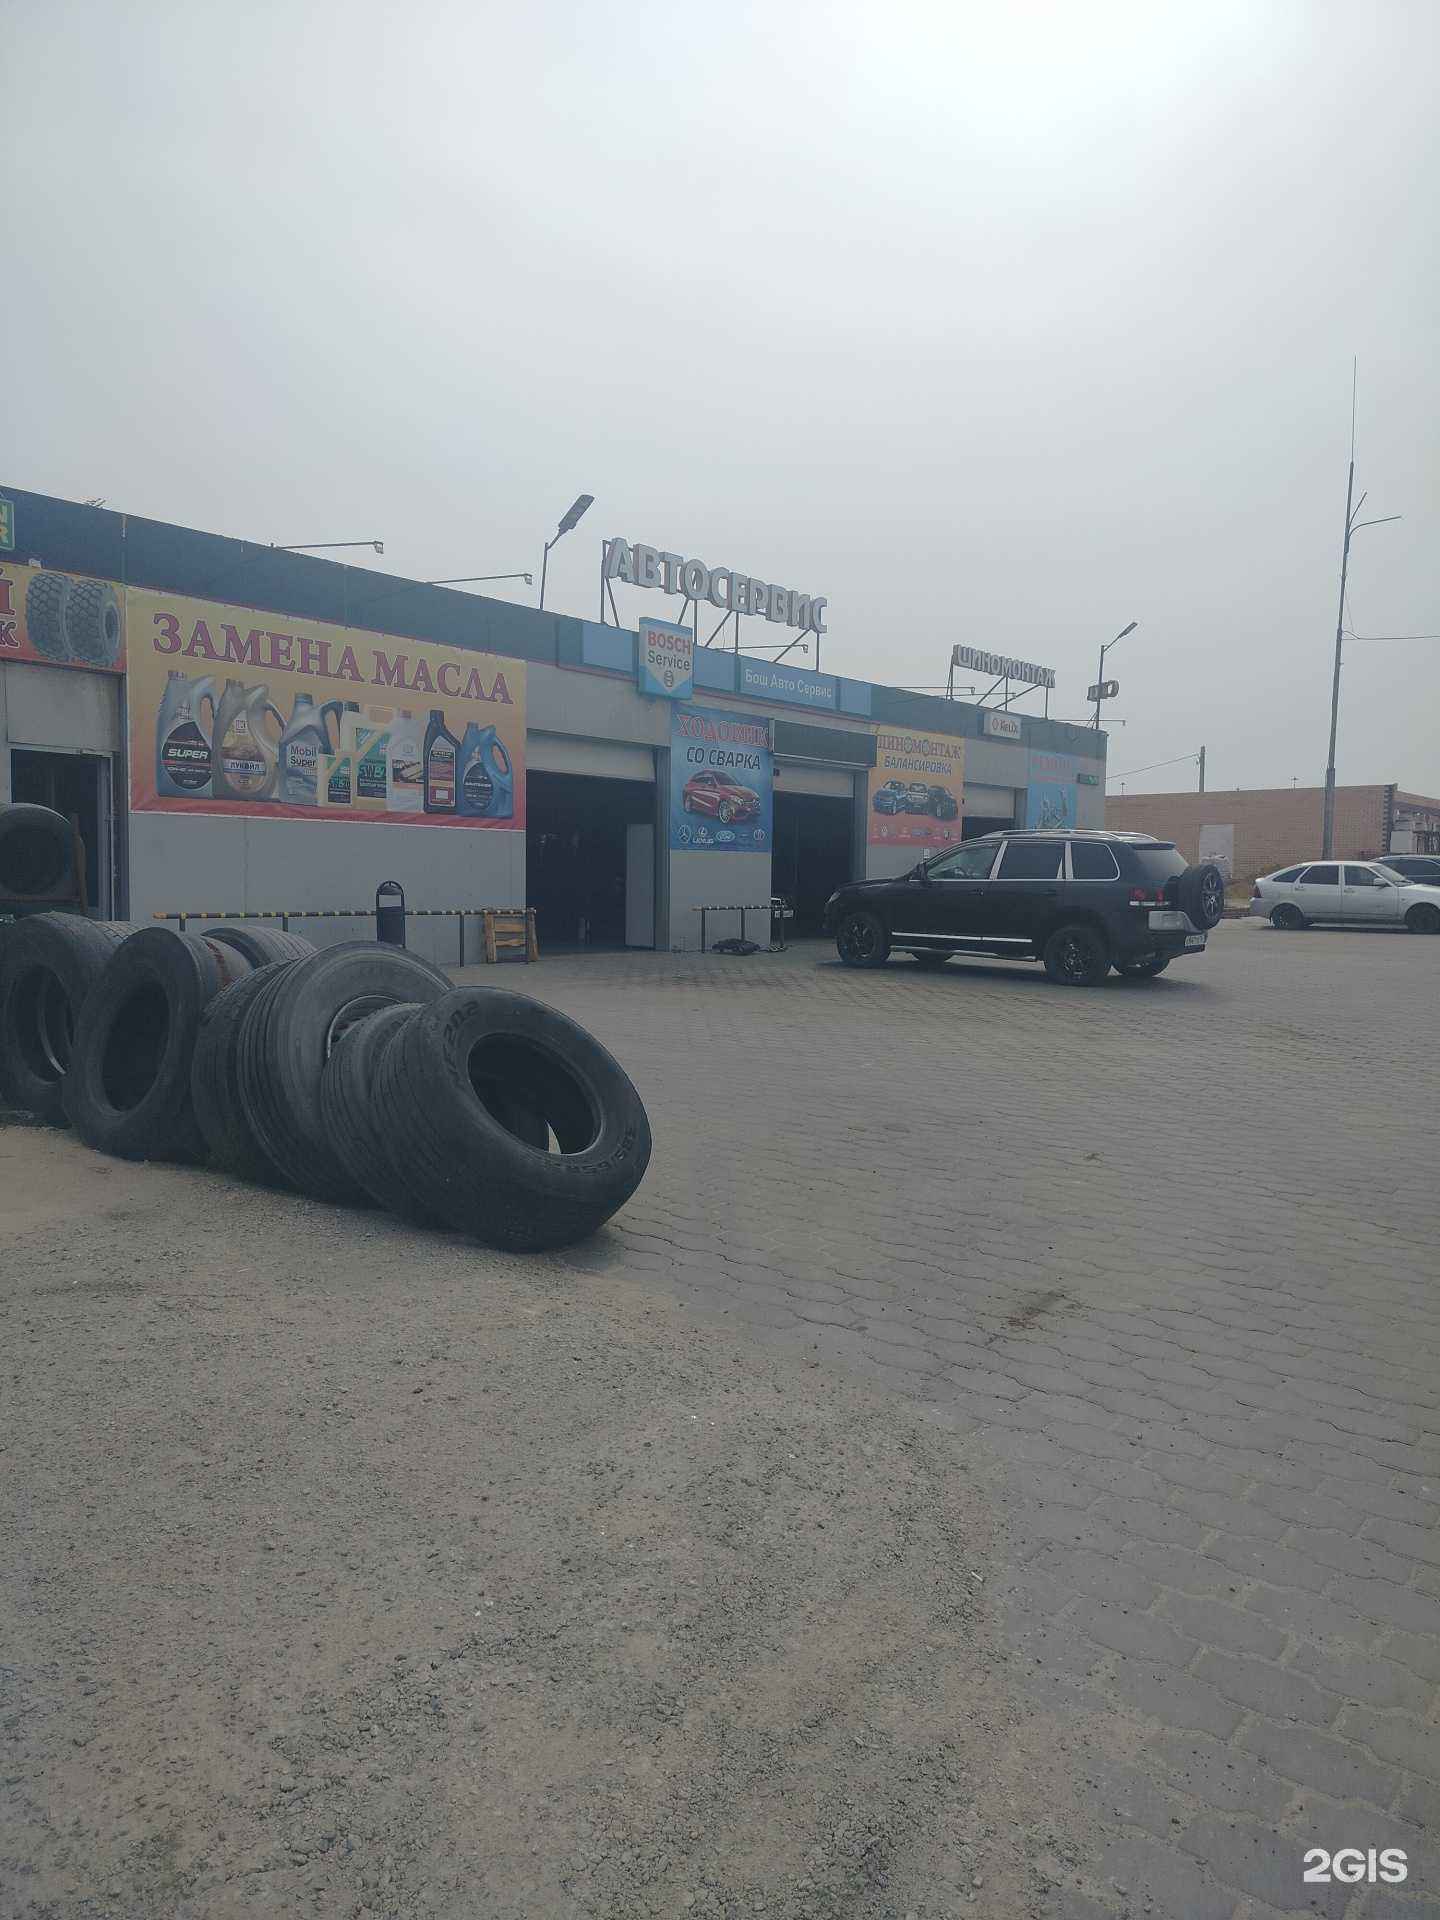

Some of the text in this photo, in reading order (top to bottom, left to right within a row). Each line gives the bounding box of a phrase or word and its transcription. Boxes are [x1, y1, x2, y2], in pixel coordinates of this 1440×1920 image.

[605, 537, 828, 634] АВТОСЕРВИС
[647, 630, 691, 656] BOSCH
[152, 613, 514, 705] ЗАМЕНА МАСЛА
[647, 649, 691, 672] Service
[953, 644, 1056, 689] ШИНОМОНТАЖ
[745, 668, 833, 699] Бош Авто Сервис
[167, 748, 209, 760] SUPER
[290, 744, 317, 756] Mobil
[290, 755, 316, 768] Super
[687, 747, 761, 770] СО СВАРКА
